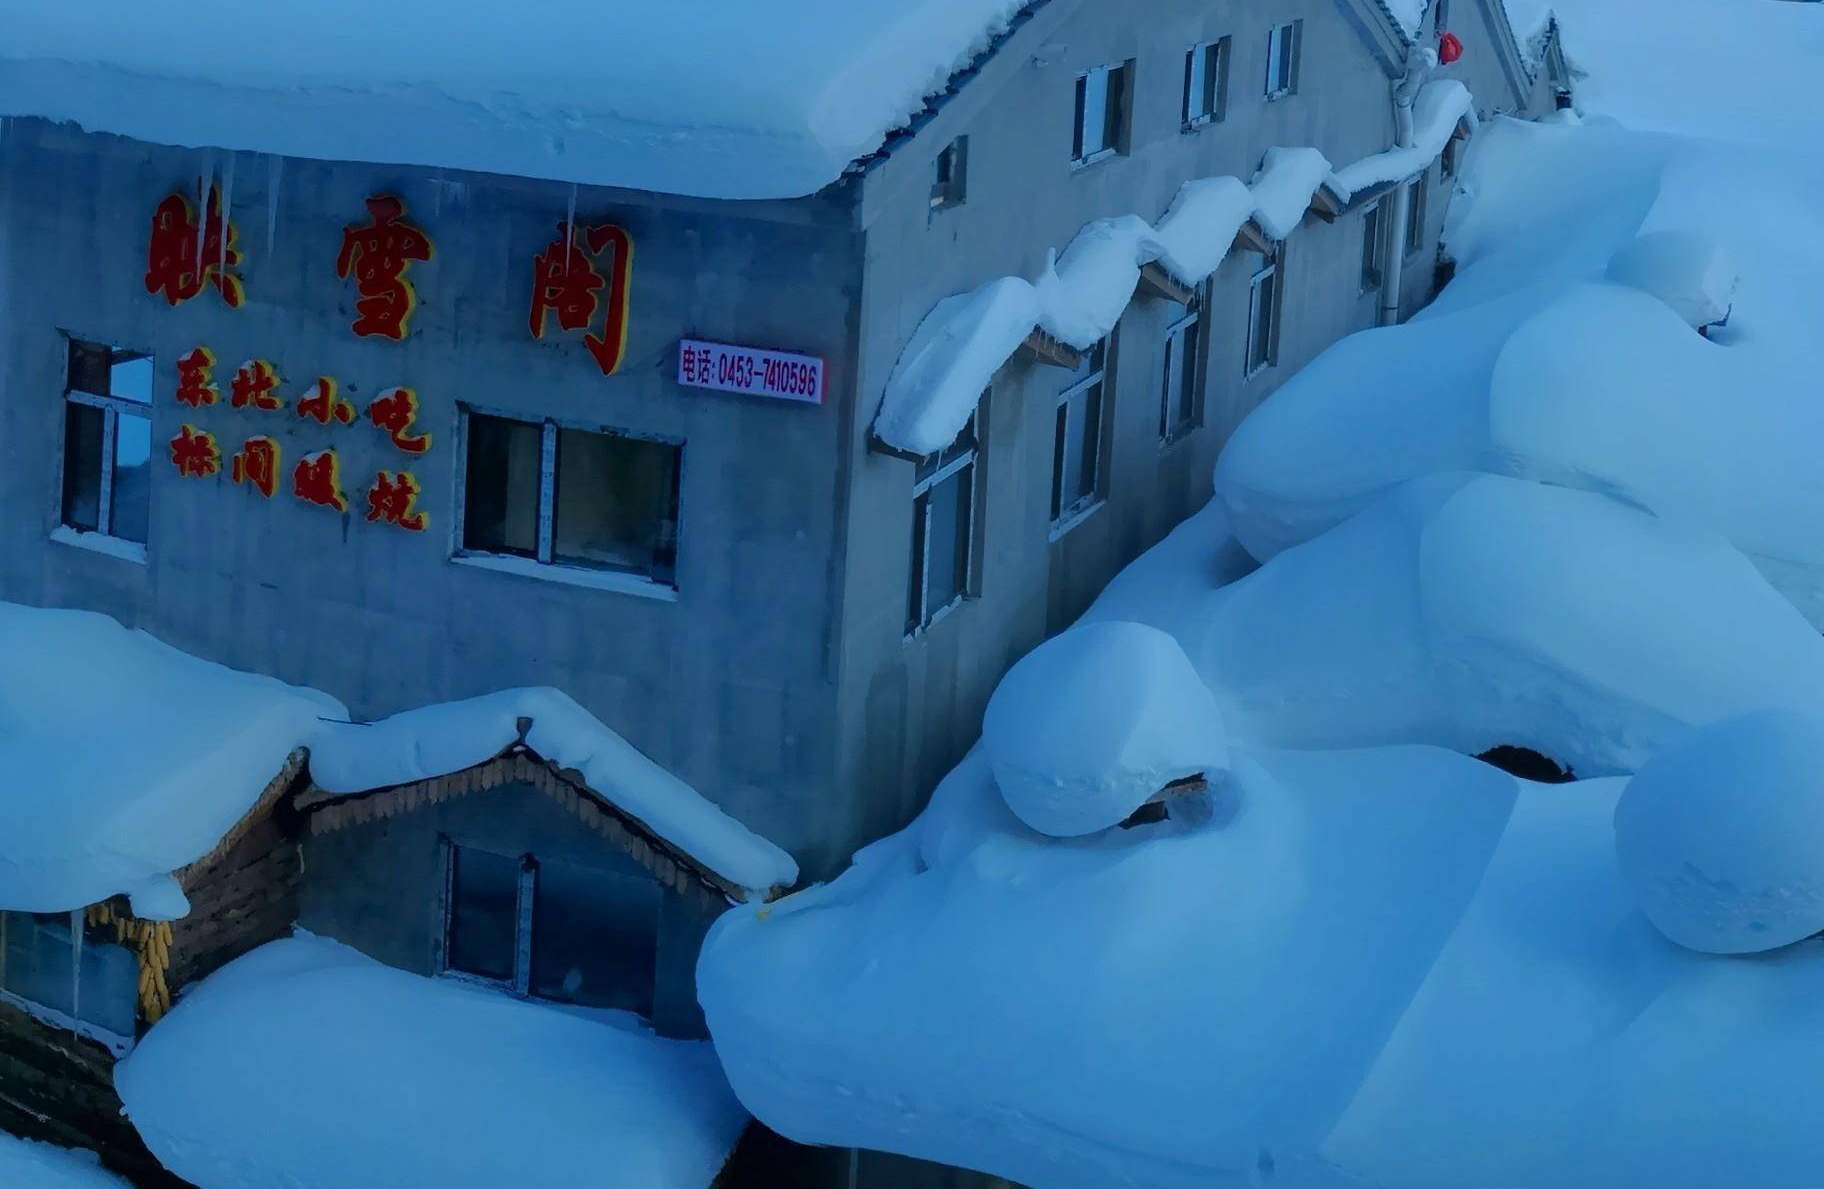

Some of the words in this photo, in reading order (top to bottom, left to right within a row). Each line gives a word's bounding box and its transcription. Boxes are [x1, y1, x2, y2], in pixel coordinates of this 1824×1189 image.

[176, 346, 433, 455] 东北小吃
[170, 423, 430, 532] 标间暖炕
